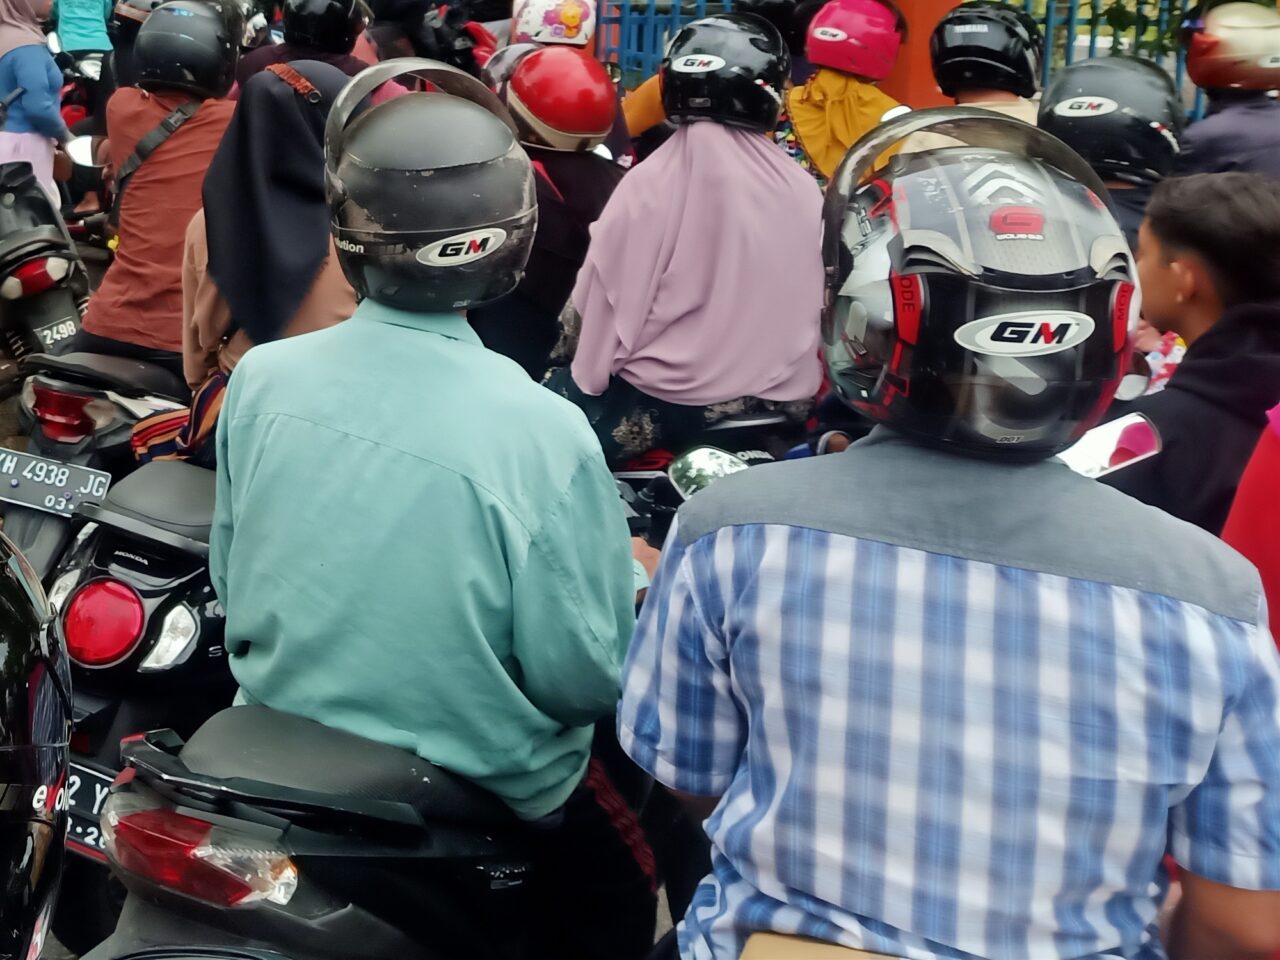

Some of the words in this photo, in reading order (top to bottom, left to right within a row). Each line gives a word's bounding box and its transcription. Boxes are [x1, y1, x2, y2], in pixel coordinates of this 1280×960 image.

[683, 58, 714, 68] GM
[1068, 101, 1104, 111] GM
[437, 236, 492, 258] GM
[900, 277, 916, 313] ODE
[42, 320, 77, 345] 2498
[990, 321, 1072, 344] GM
[22, 460, 70, 488] 4938
[79, 473, 107, 498] JG
[113, 549, 149, 566] HONDA
